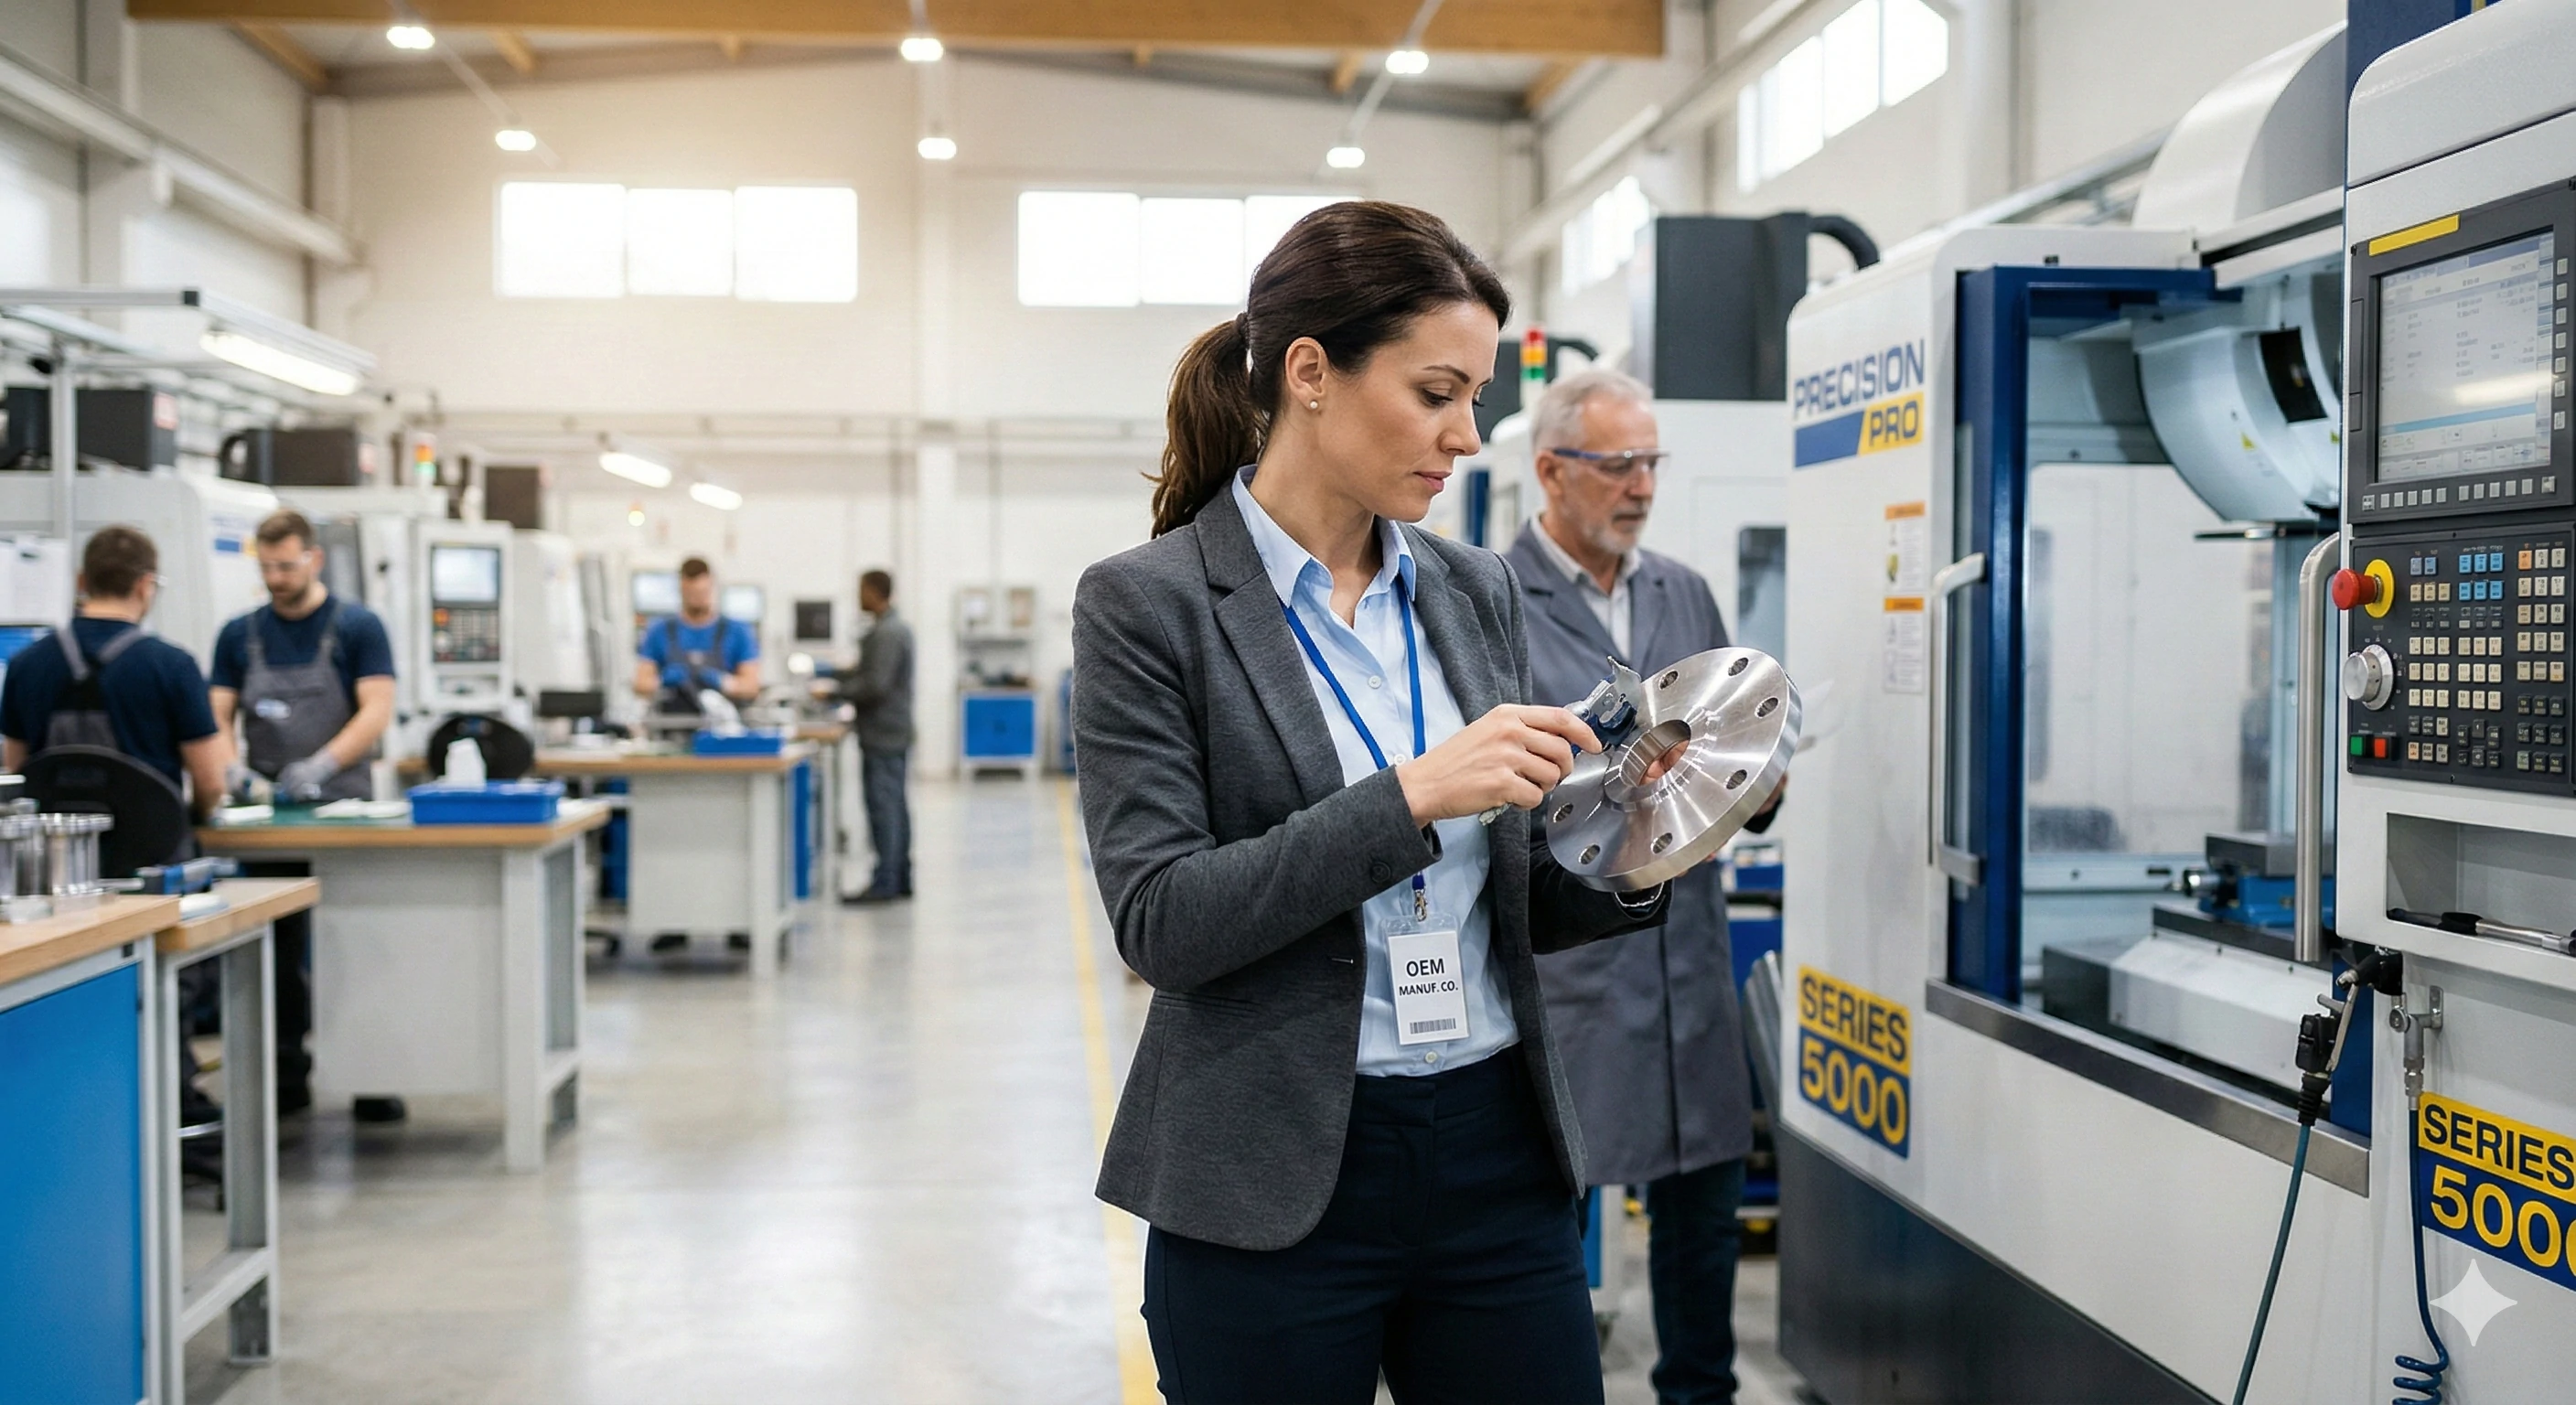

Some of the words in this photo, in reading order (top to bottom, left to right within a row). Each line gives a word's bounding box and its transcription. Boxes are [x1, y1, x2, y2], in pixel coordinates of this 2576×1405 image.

[1795, 338, 1925, 420] PRECISION
[1870, 401, 1918, 446] PRO
[1399, 982, 1439, 996] MANUF.
[1441, 981, 1458, 992] CO.
[1407, 959, 1444, 977] OEM
[1801, 975, 1906, 1062] SERIES
[1801, 1035, 1907, 1144] 5000
[2424, 1104, 2574, 1191] SERIES
[2431, 1164, 2576, 1277] 500
